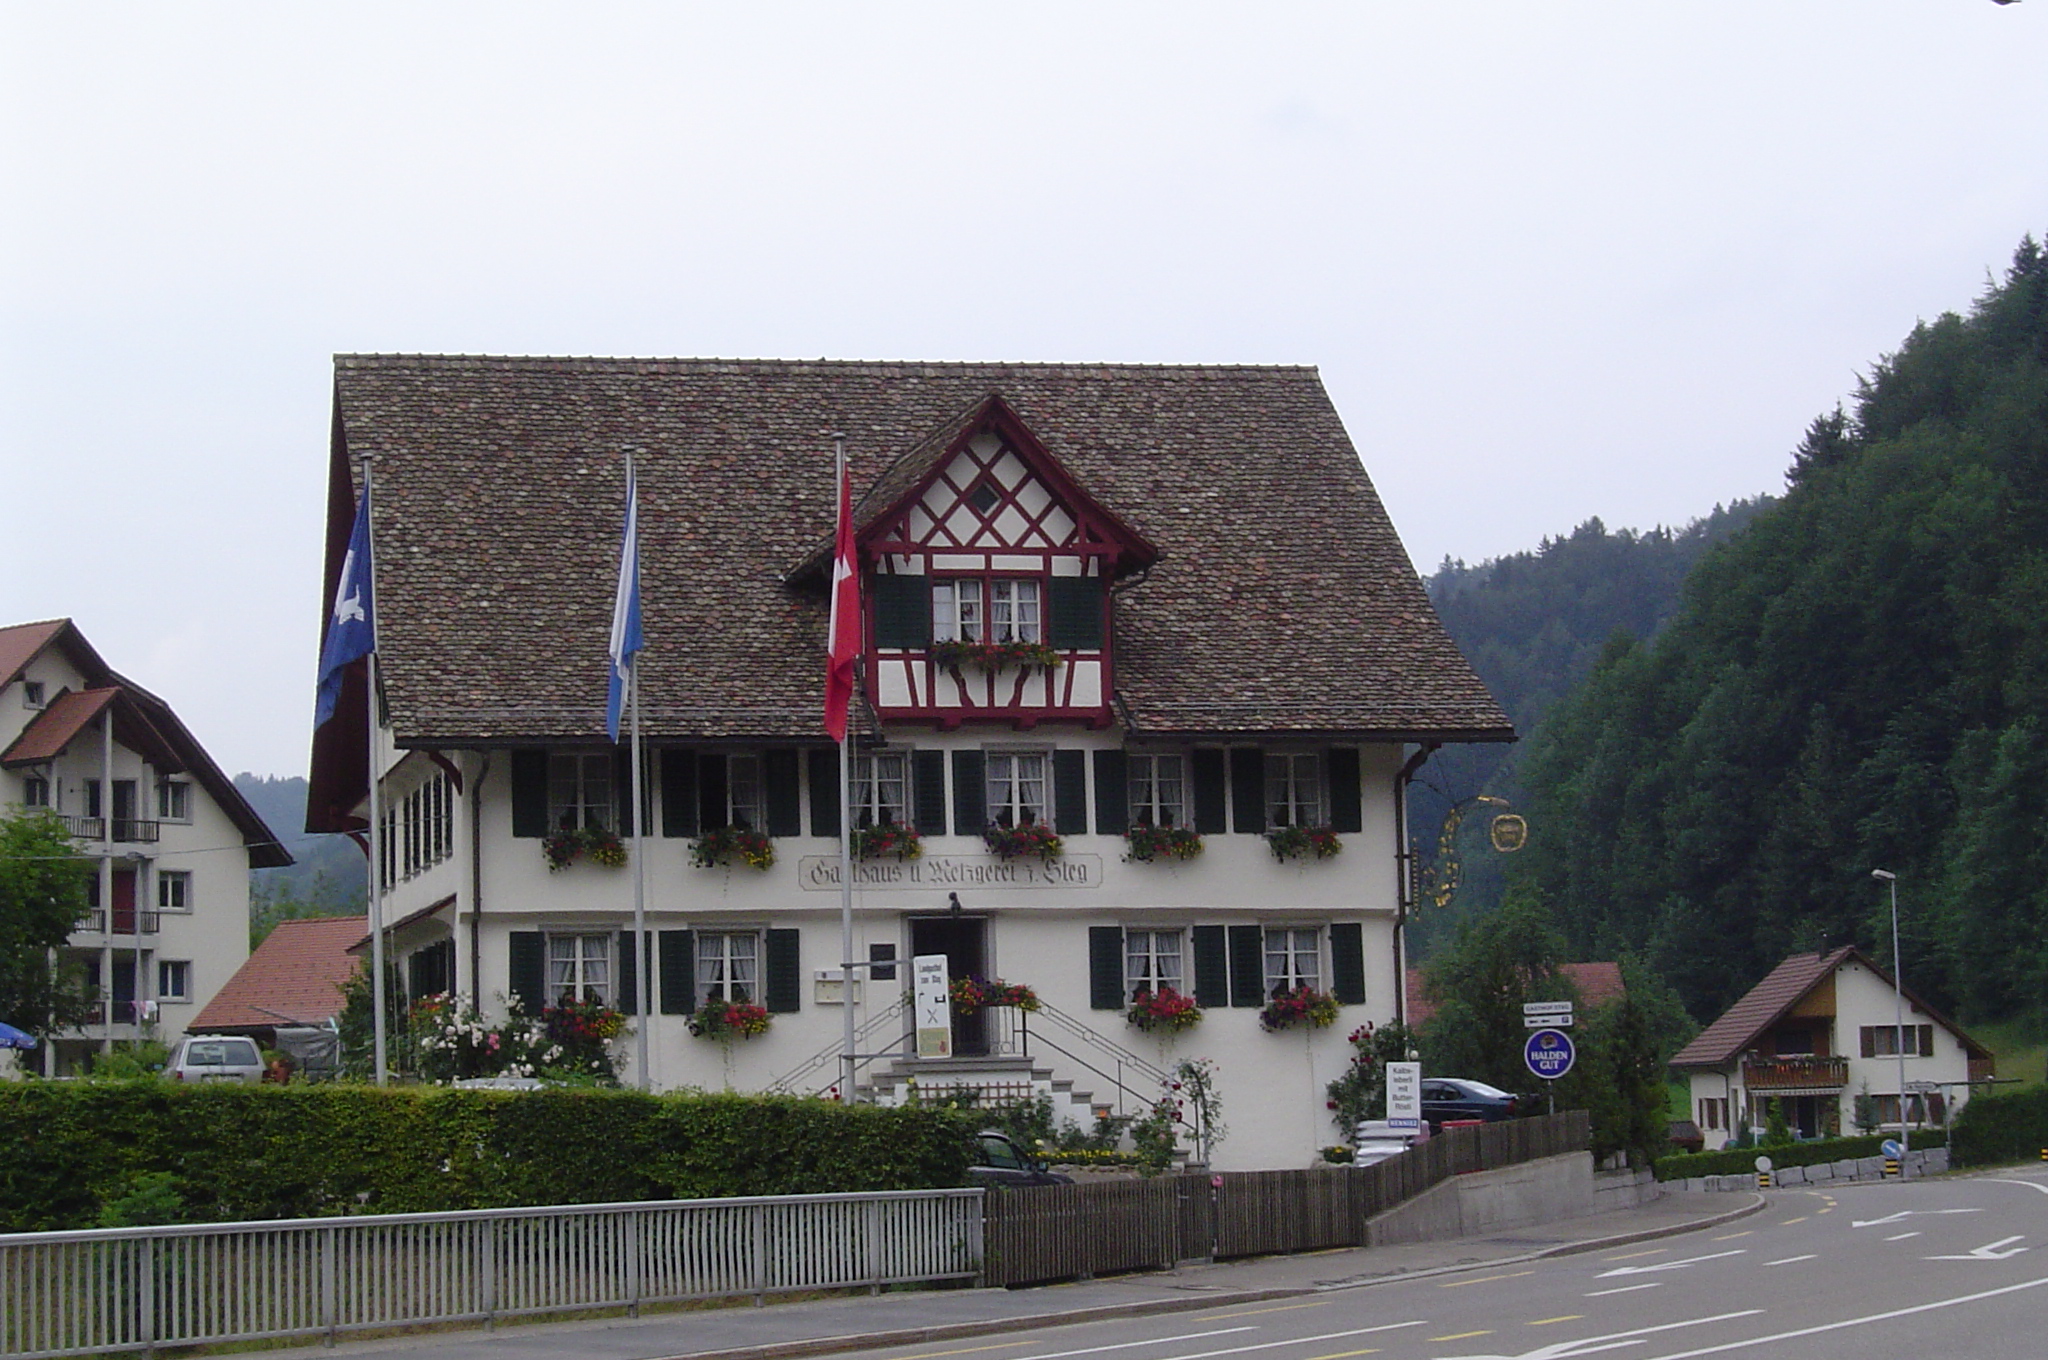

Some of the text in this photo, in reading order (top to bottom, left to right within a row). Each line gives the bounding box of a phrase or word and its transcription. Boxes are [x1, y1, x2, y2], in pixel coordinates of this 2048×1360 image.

[810, 859, 902, 885] Gathaus
[1043, 858, 1088, 885] Steg
[1531, 1051, 1568, 1060] HALDEN
[1540, 1061, 1559, 1069] GUT
